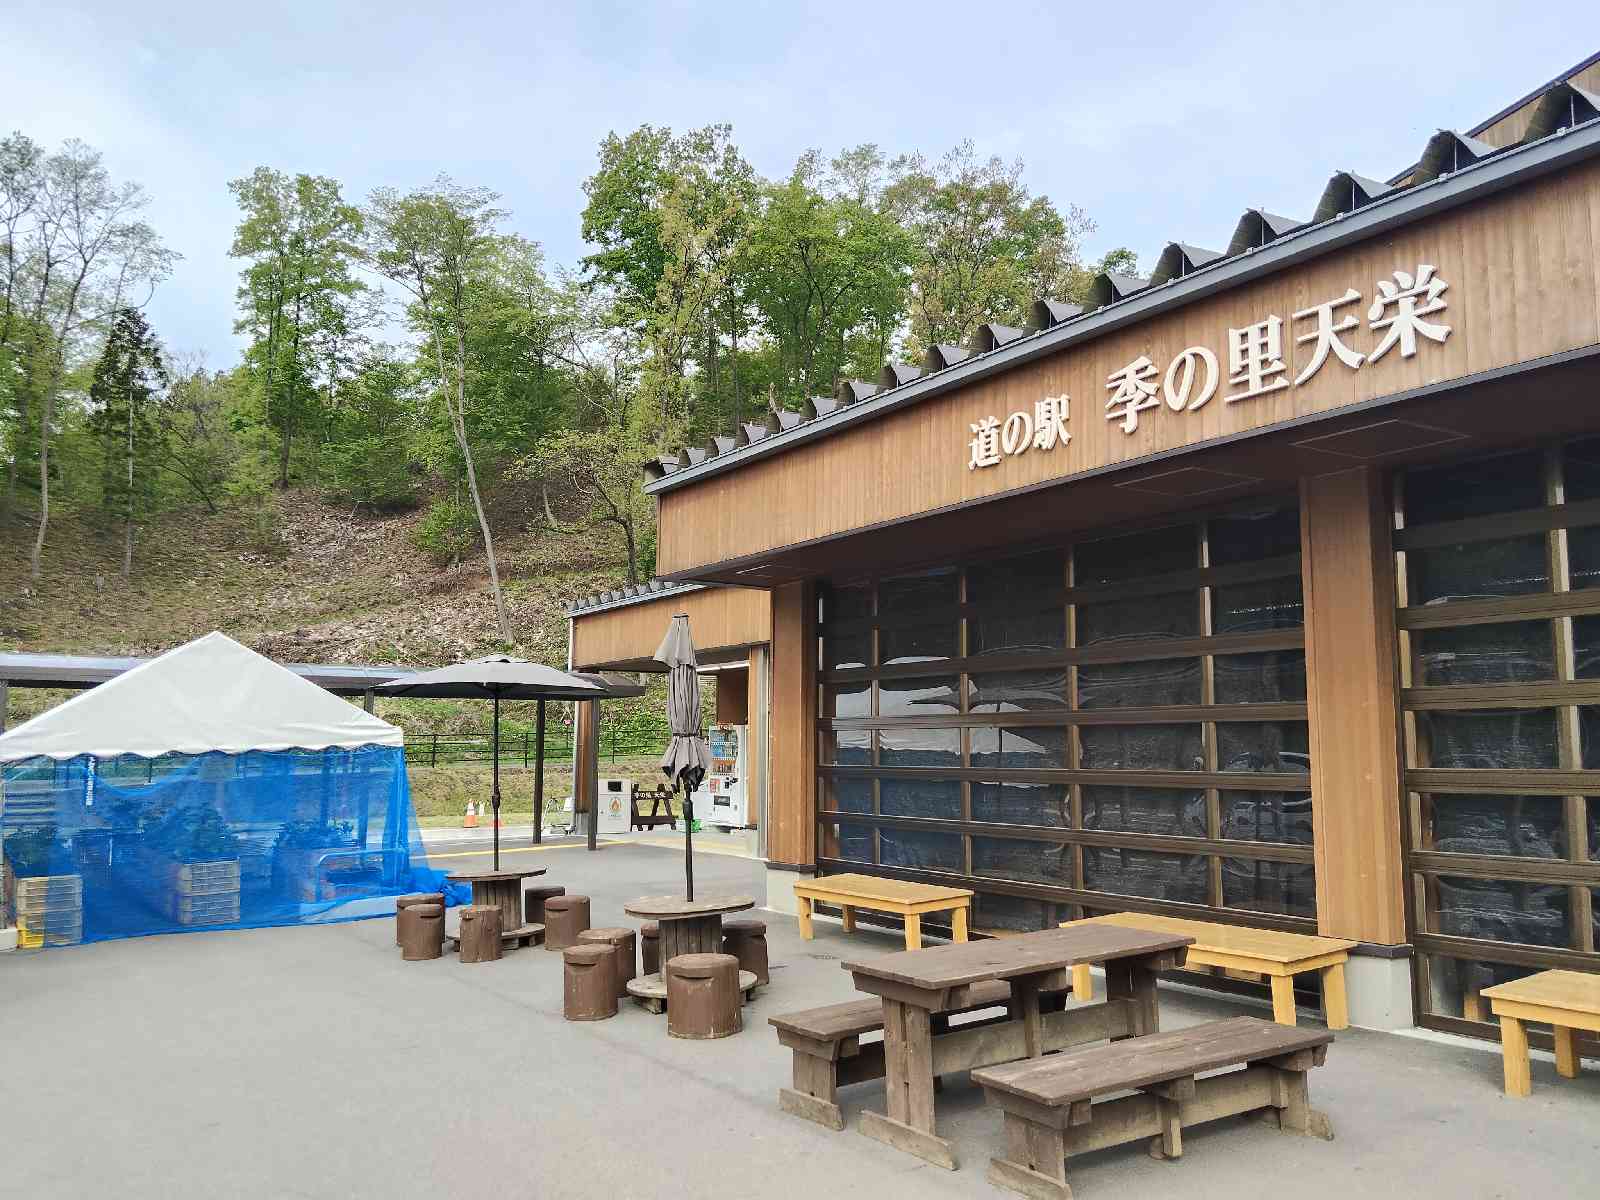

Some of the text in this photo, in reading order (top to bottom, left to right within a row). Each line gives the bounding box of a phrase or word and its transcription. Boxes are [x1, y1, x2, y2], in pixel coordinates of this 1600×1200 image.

[968, 264, 1452, 470] 道の駅 季の里天栄
